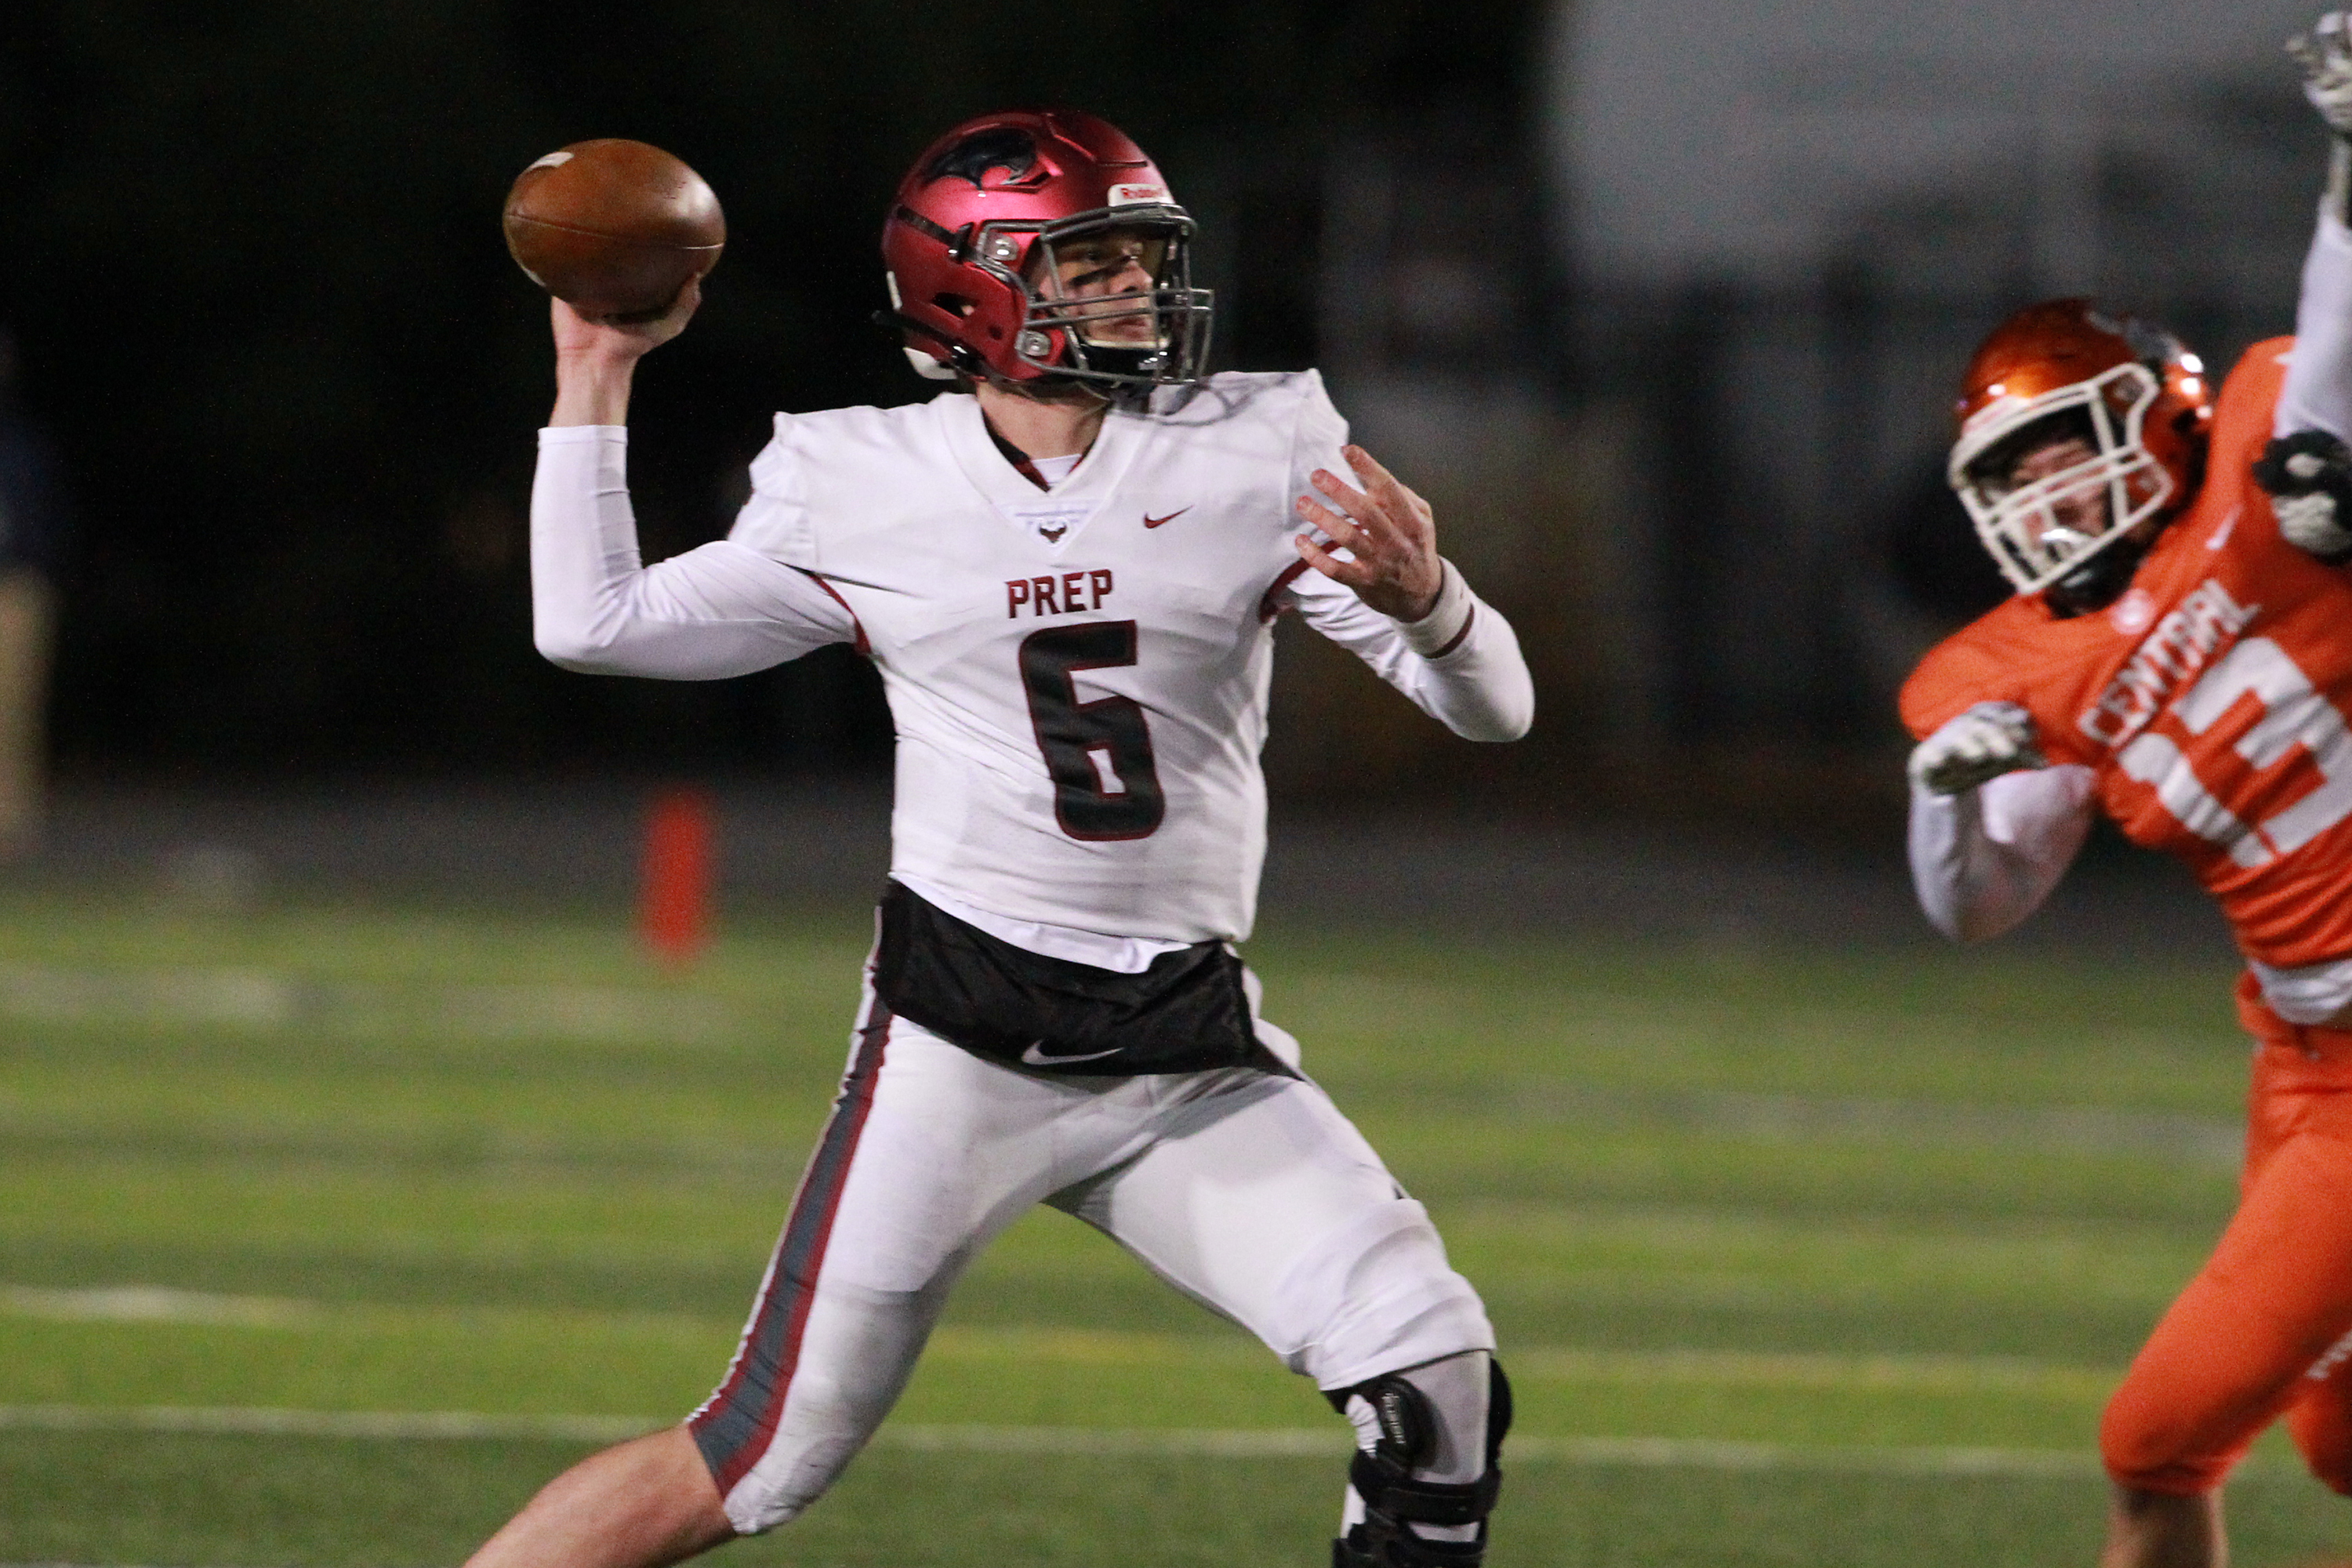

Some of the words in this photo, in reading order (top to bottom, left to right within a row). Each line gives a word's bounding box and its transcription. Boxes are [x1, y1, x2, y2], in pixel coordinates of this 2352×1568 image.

[1005, 569, 1112, 619] PREP
[1018, 619, 1166, 841] 6
[2118, 637, 2352, 868] 13
